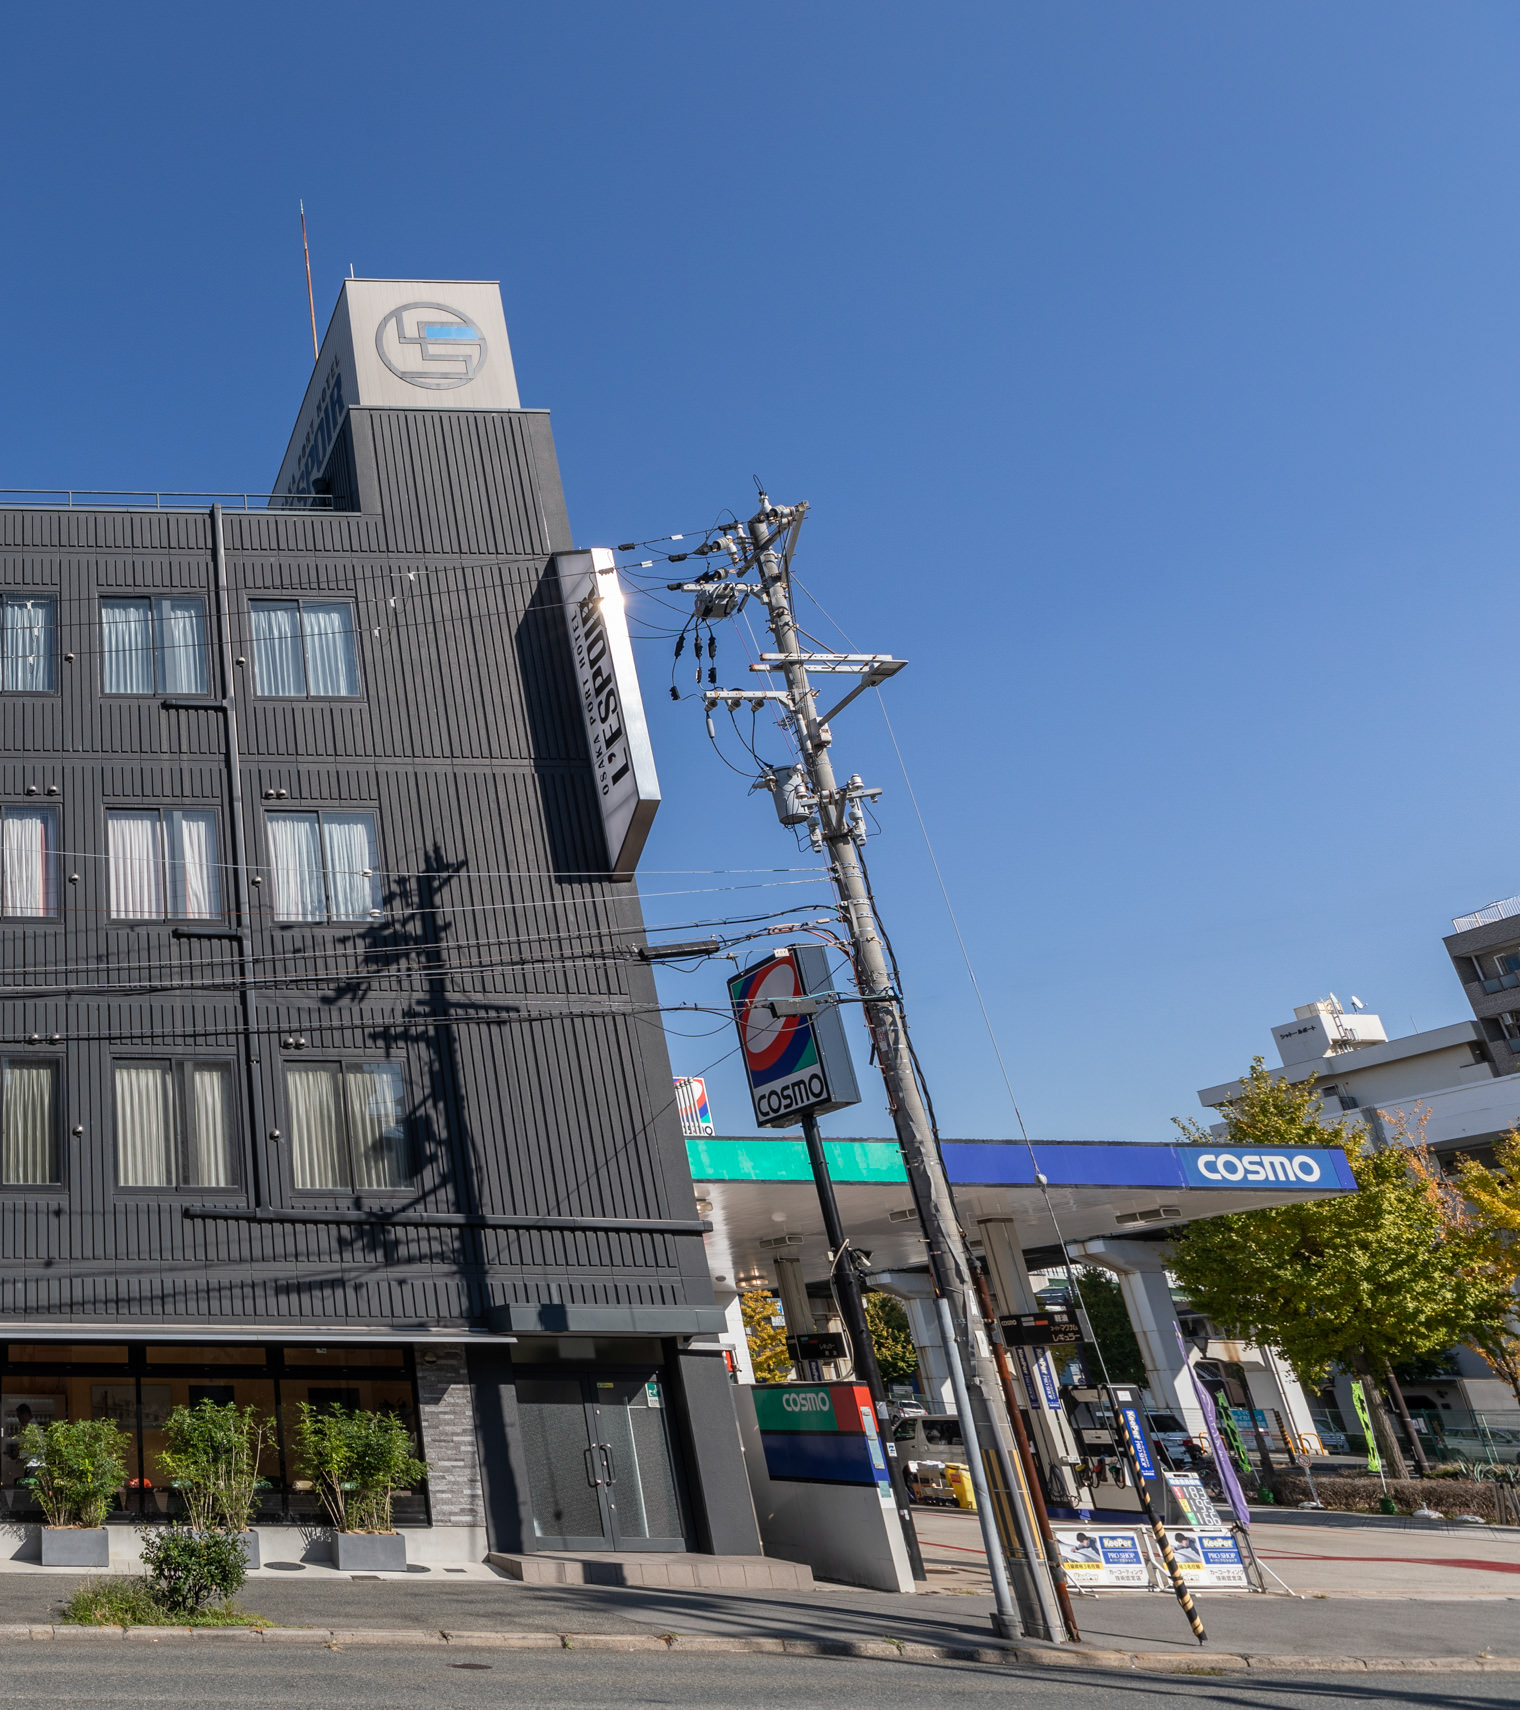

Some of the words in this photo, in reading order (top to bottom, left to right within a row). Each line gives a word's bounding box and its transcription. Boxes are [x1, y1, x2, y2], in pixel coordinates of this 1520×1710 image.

[316, 351, 341, 417] HOTEL
[571, 609, 586, 670] HOTEL
[582, 678, 597, 726] PORT
[593, 735, 609, 796] OSAKA
[757, 1073, 825, 1118] COSMO
[1197, 1153, 1321, 1183] COSMO
[1051, 1332, 1081, 1342] レギュラー
[782, 1391, 830, 1412] COSMO
[1126, 1410, 1141, 1440] KeePer
[1139, 1453, 1148, 1468] SHOP
[1183, 1486, 1207, 1500] 183
[1190, 1499, 1215, 1513] 195
[1197, 1512, 1222, 1526] 166
[1102, 1537, 1132, 1548] KeePer
[1202, 1537, 1233, 1548] KeePer
